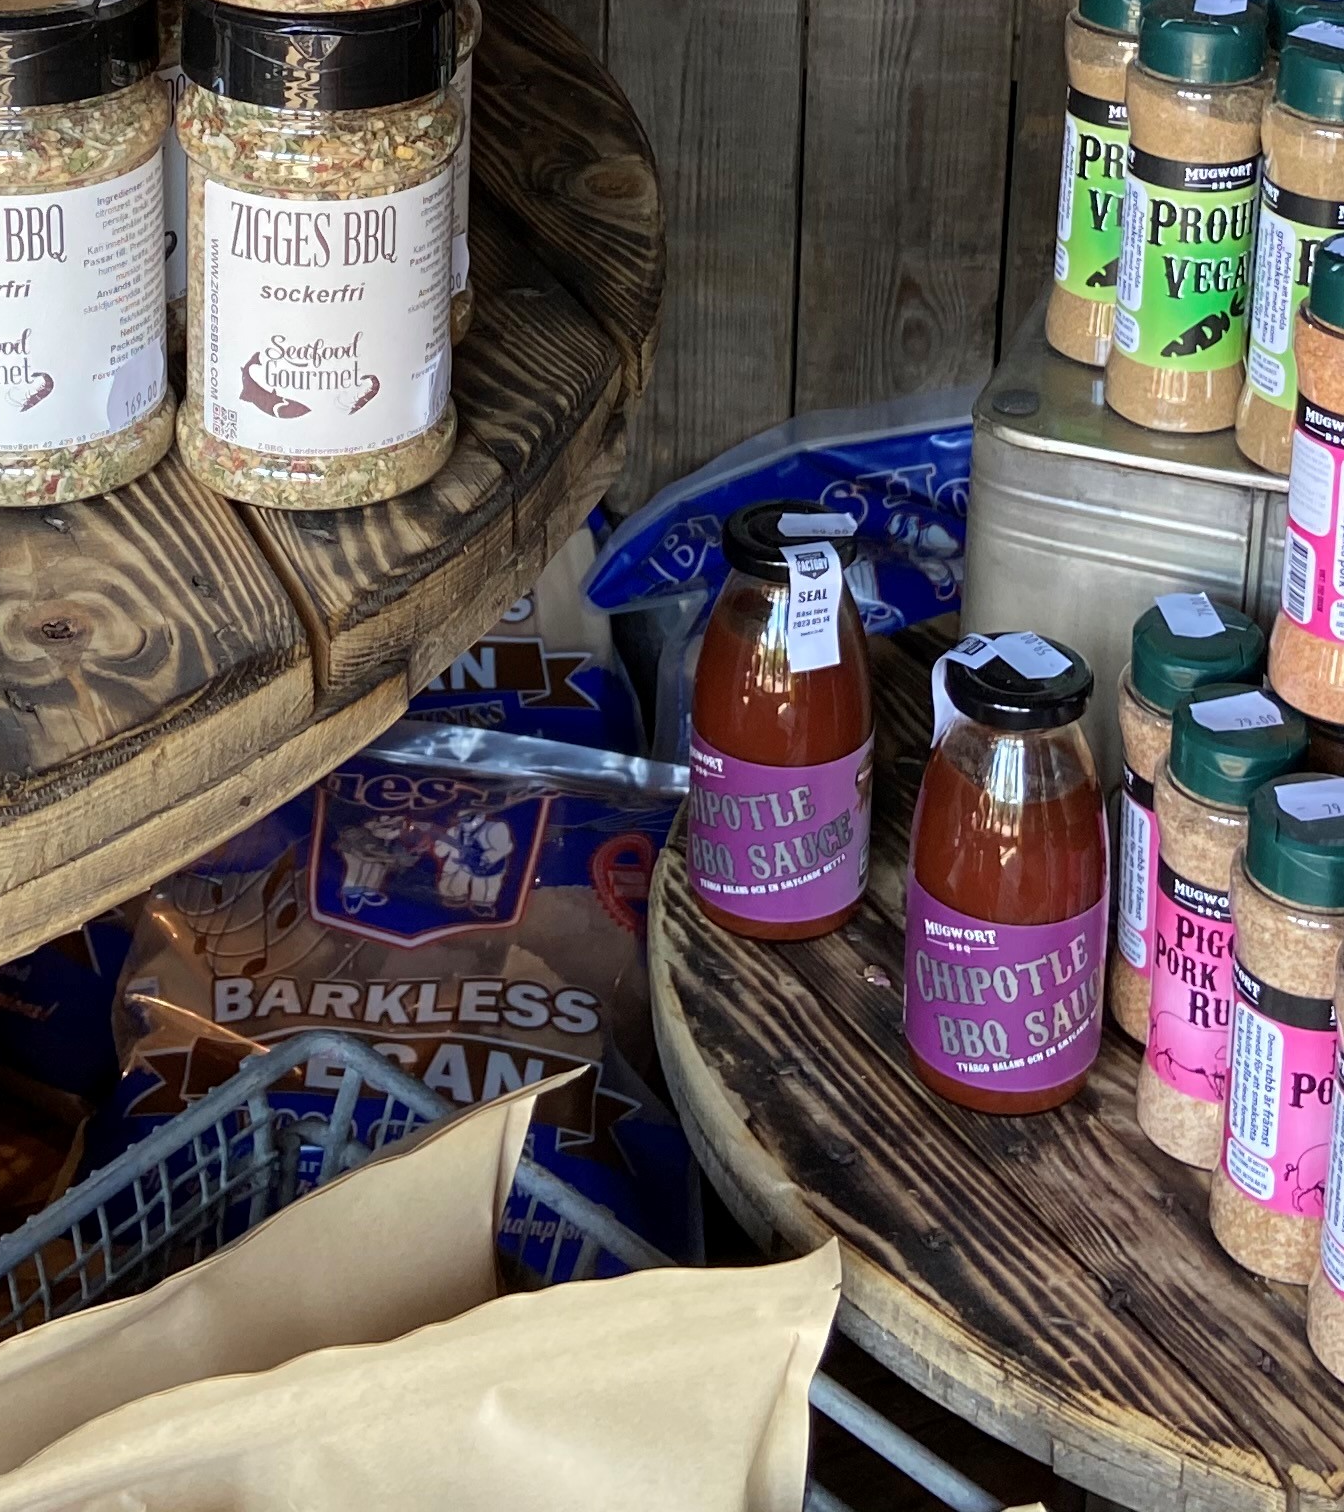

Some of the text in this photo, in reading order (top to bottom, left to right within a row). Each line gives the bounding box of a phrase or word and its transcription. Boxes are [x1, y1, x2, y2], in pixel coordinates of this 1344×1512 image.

[1184, 162, 1253, 187] MUGWORT
[4, 203, 67, 264] BBQ
[230, 200, 332, 269] ZIGGES
[342, 204, 398, 267] BBQ
[1272, 230, 1285, 290] grönsaker
[259, 281, 366, 304] sockerfri
[264, 331, 364, 369] Seafood
[264, 359, 364, 391] Gourmet
[124, 379, 158, 418] 169.00
[798, 588, 828, 604] SEAL
[1236, 713, 1278, 729] 79.00
[691, 808, 854, 884] BBQ SAUCE
[924, 918, 997, 946] MUGWORT
[915, 932, 1089, 1007] CHIPOTLE
[1155, 933, 1217, 992] PORK
[212, 976, 602, 1036] BARKLESS
[937, 1013, 1012, 1061] BBQ
[1027, 1052, 1044, 1065] OCH
